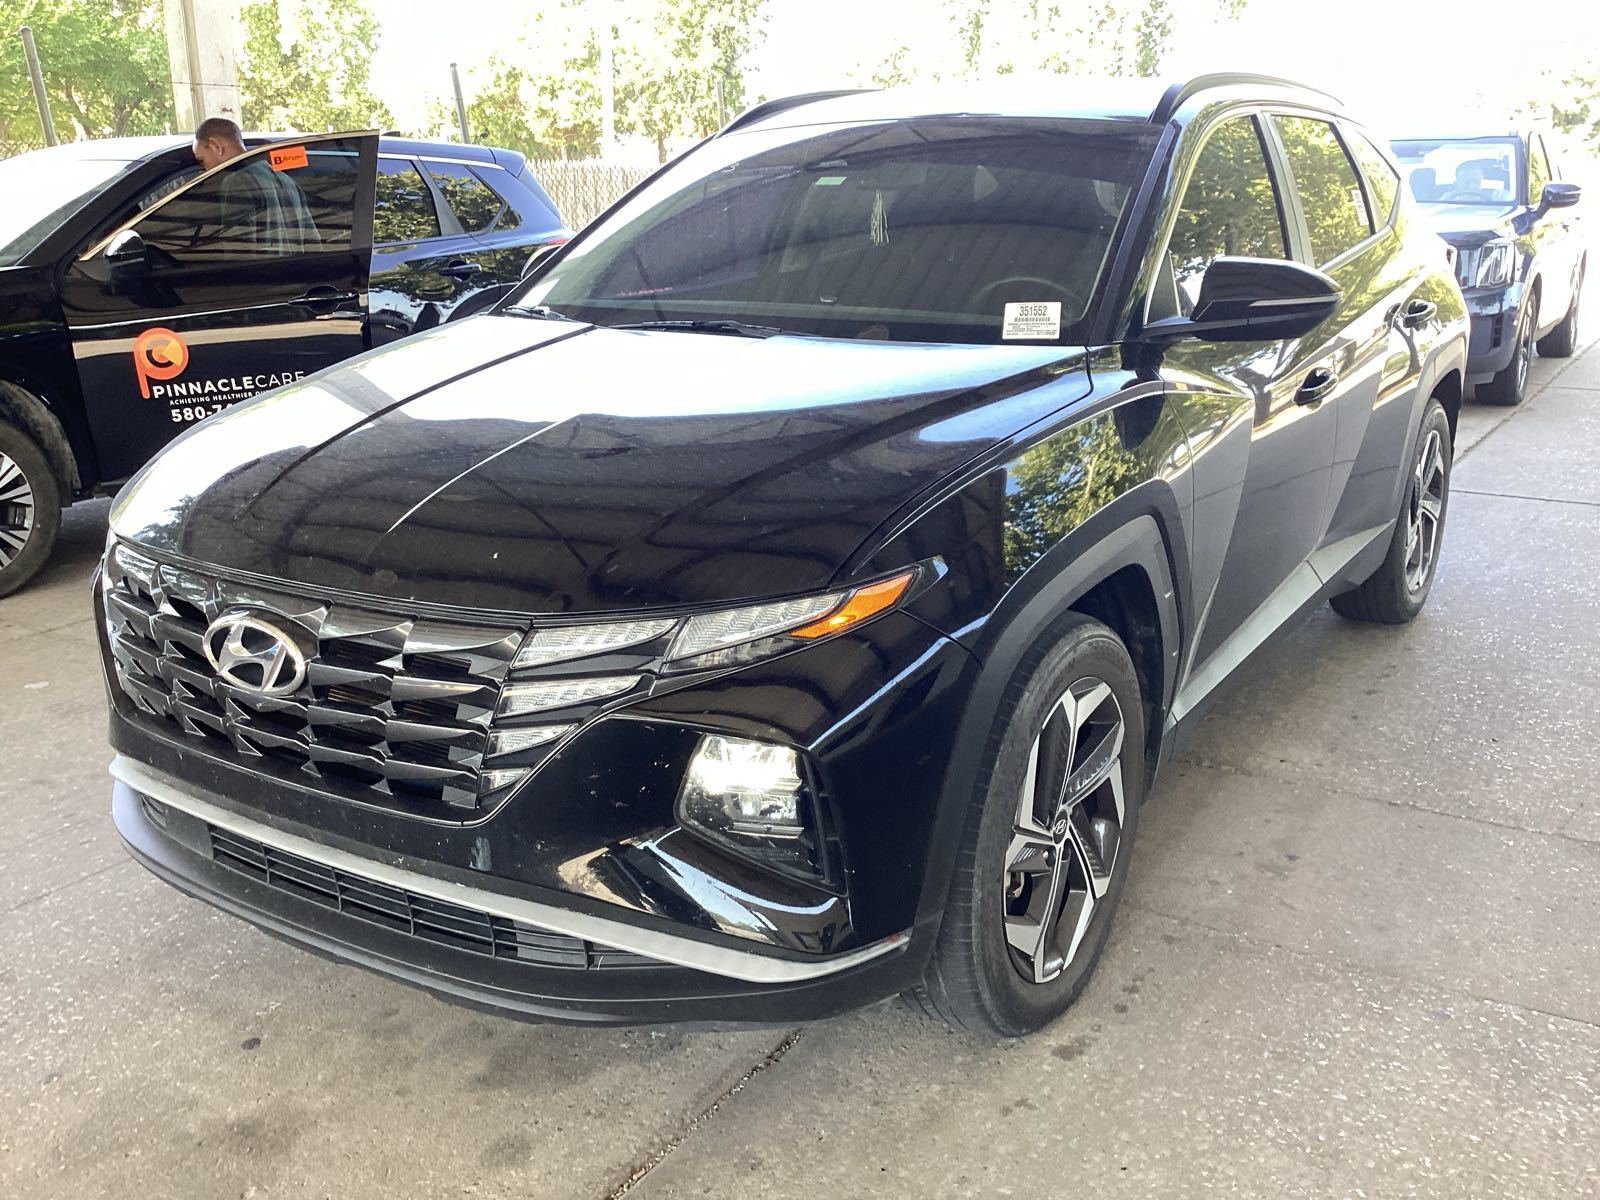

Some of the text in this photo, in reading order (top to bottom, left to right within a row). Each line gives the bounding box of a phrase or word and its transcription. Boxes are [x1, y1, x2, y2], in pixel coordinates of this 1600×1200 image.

[1019, 305, 1048, 316] 351552
[170, 395, 210, 405] ACHIEVING
[213, 391, 253, 401] HEALTHIER
